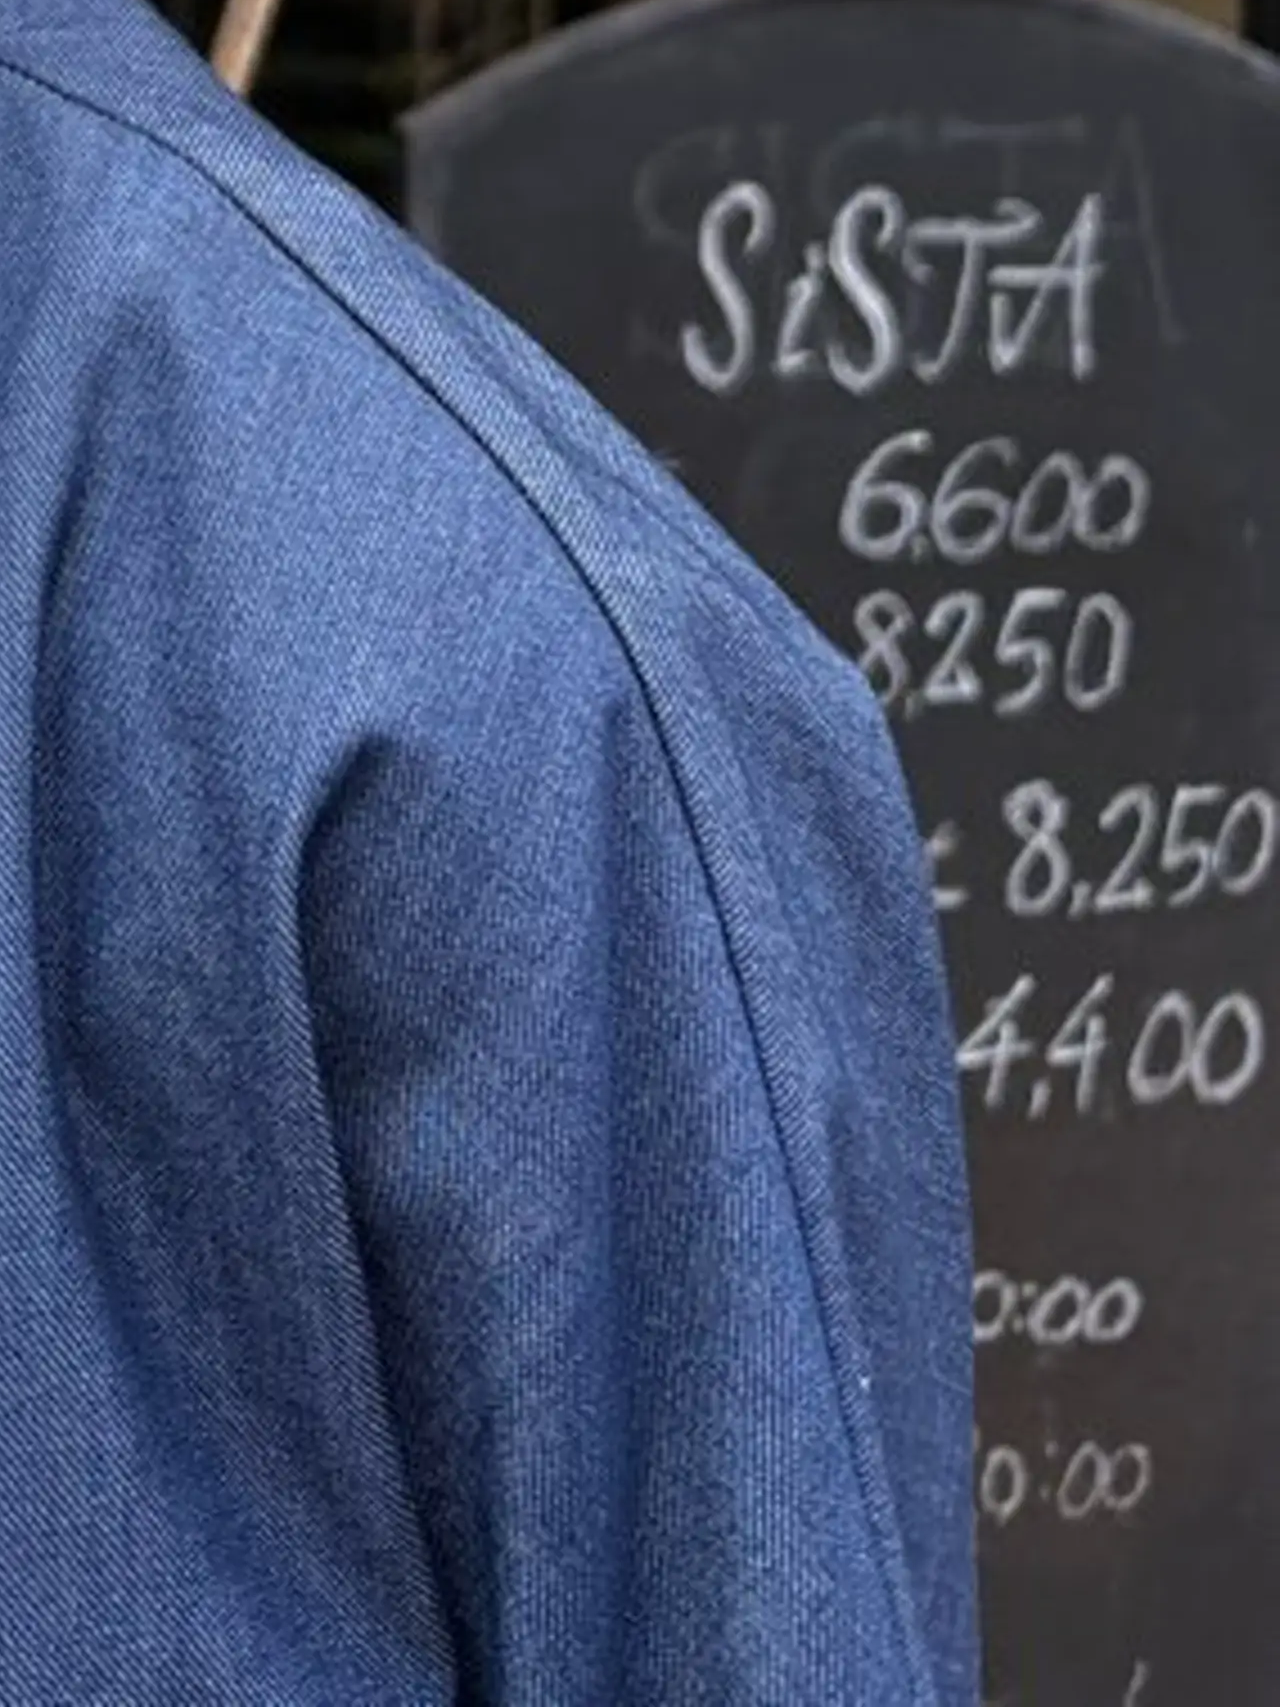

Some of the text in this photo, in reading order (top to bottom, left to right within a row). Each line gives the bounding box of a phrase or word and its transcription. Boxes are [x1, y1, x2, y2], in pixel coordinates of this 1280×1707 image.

[1002, 778, 1278, 921] 8,250
[954, 973, 1265, 1120] 4,400
[973, 1424, 1152, 1527] 0:00
